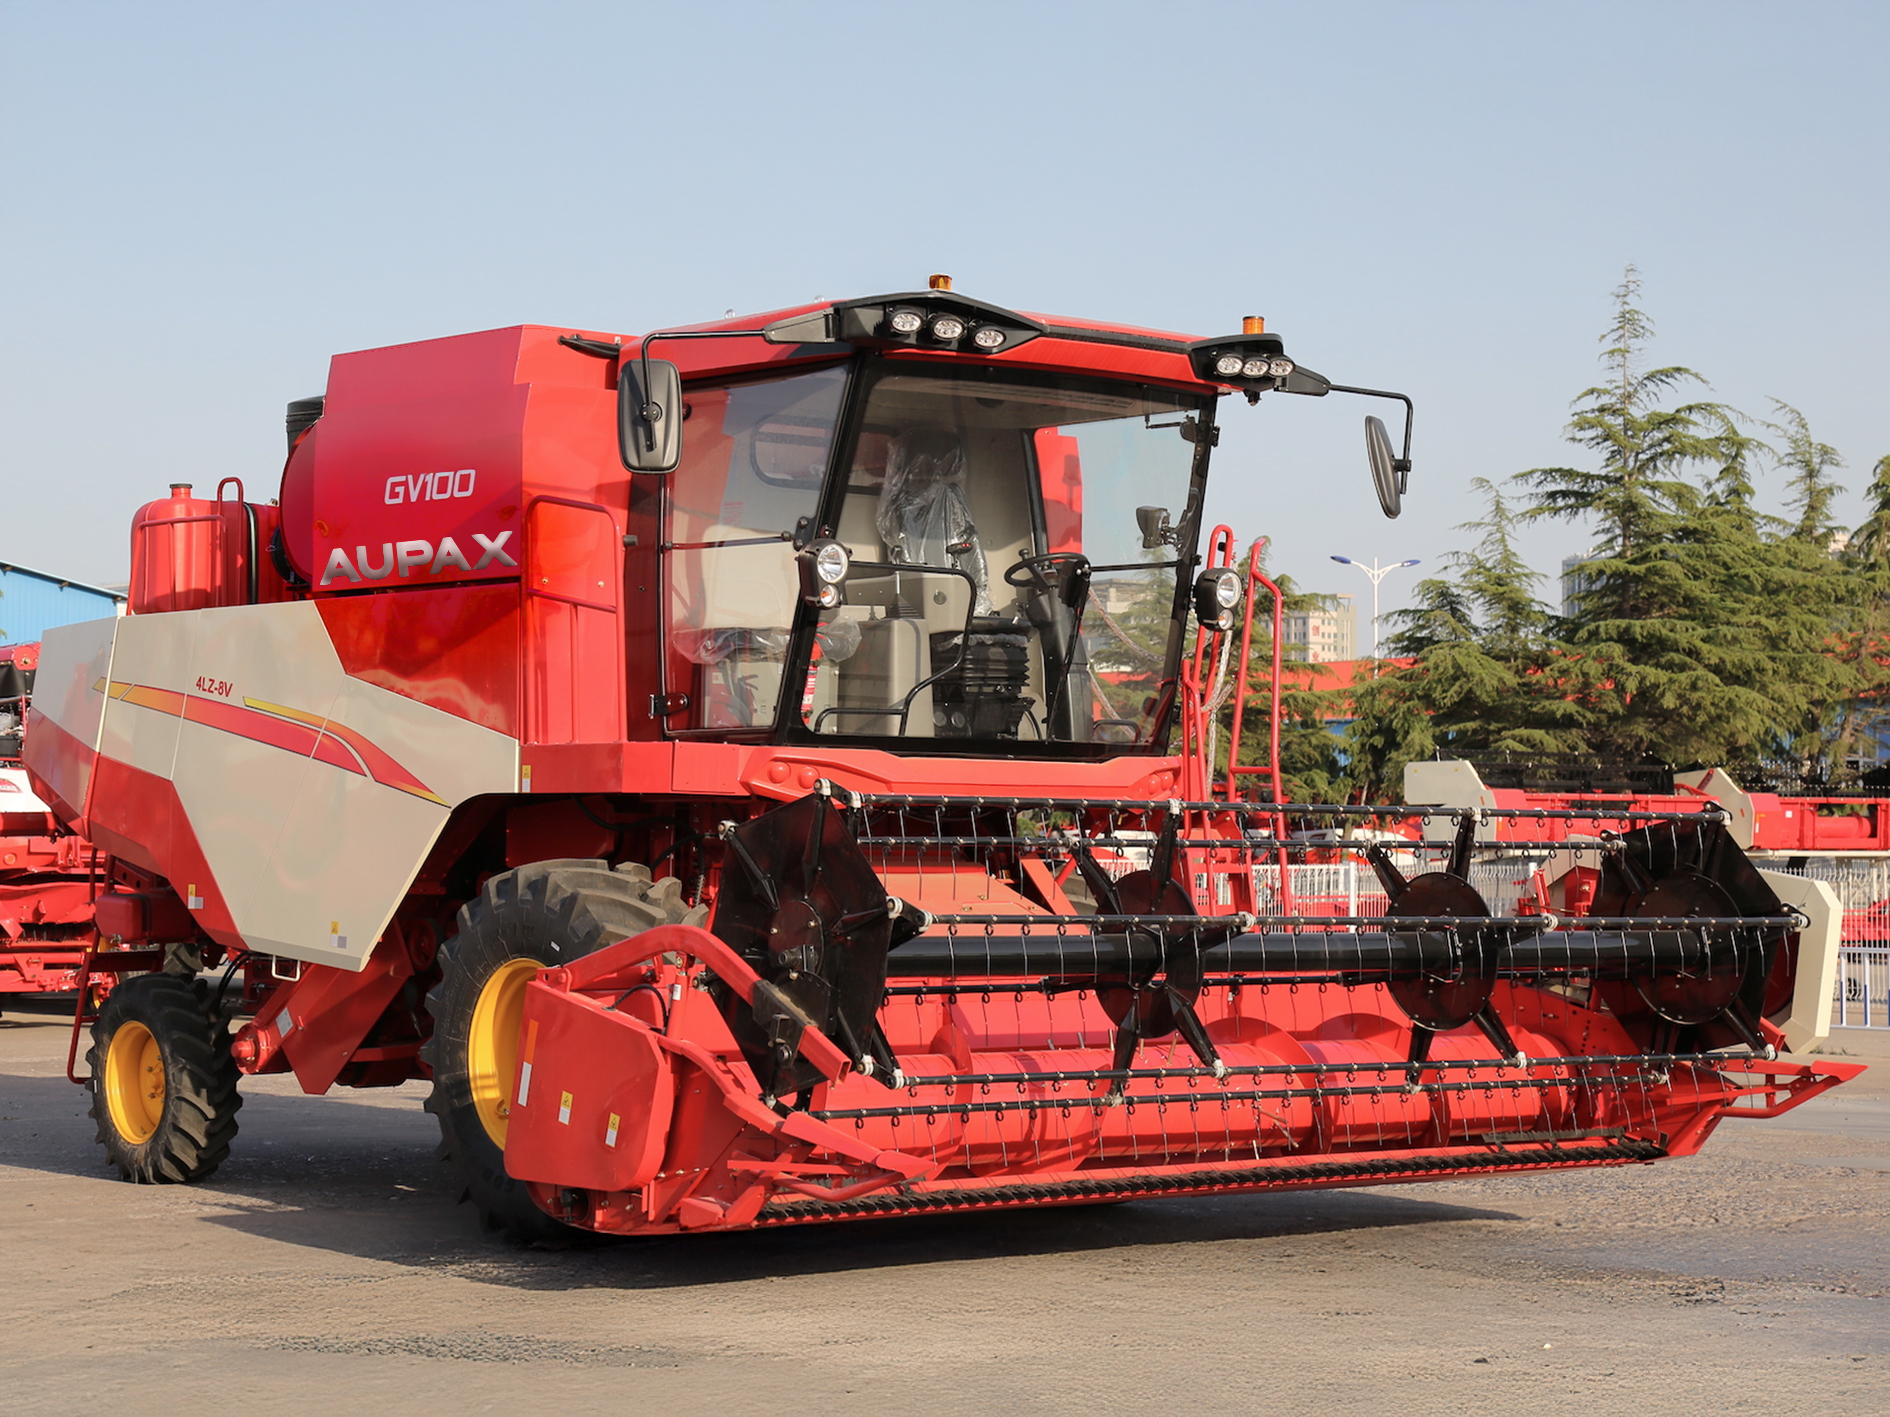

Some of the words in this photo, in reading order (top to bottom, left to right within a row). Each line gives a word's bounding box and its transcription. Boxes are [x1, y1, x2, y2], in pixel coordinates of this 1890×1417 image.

[384, 469, 476, 505] GV100
[320, 530, 517, 586] AUPAX
[195, 676, 233, 698] 4LZ-8V
